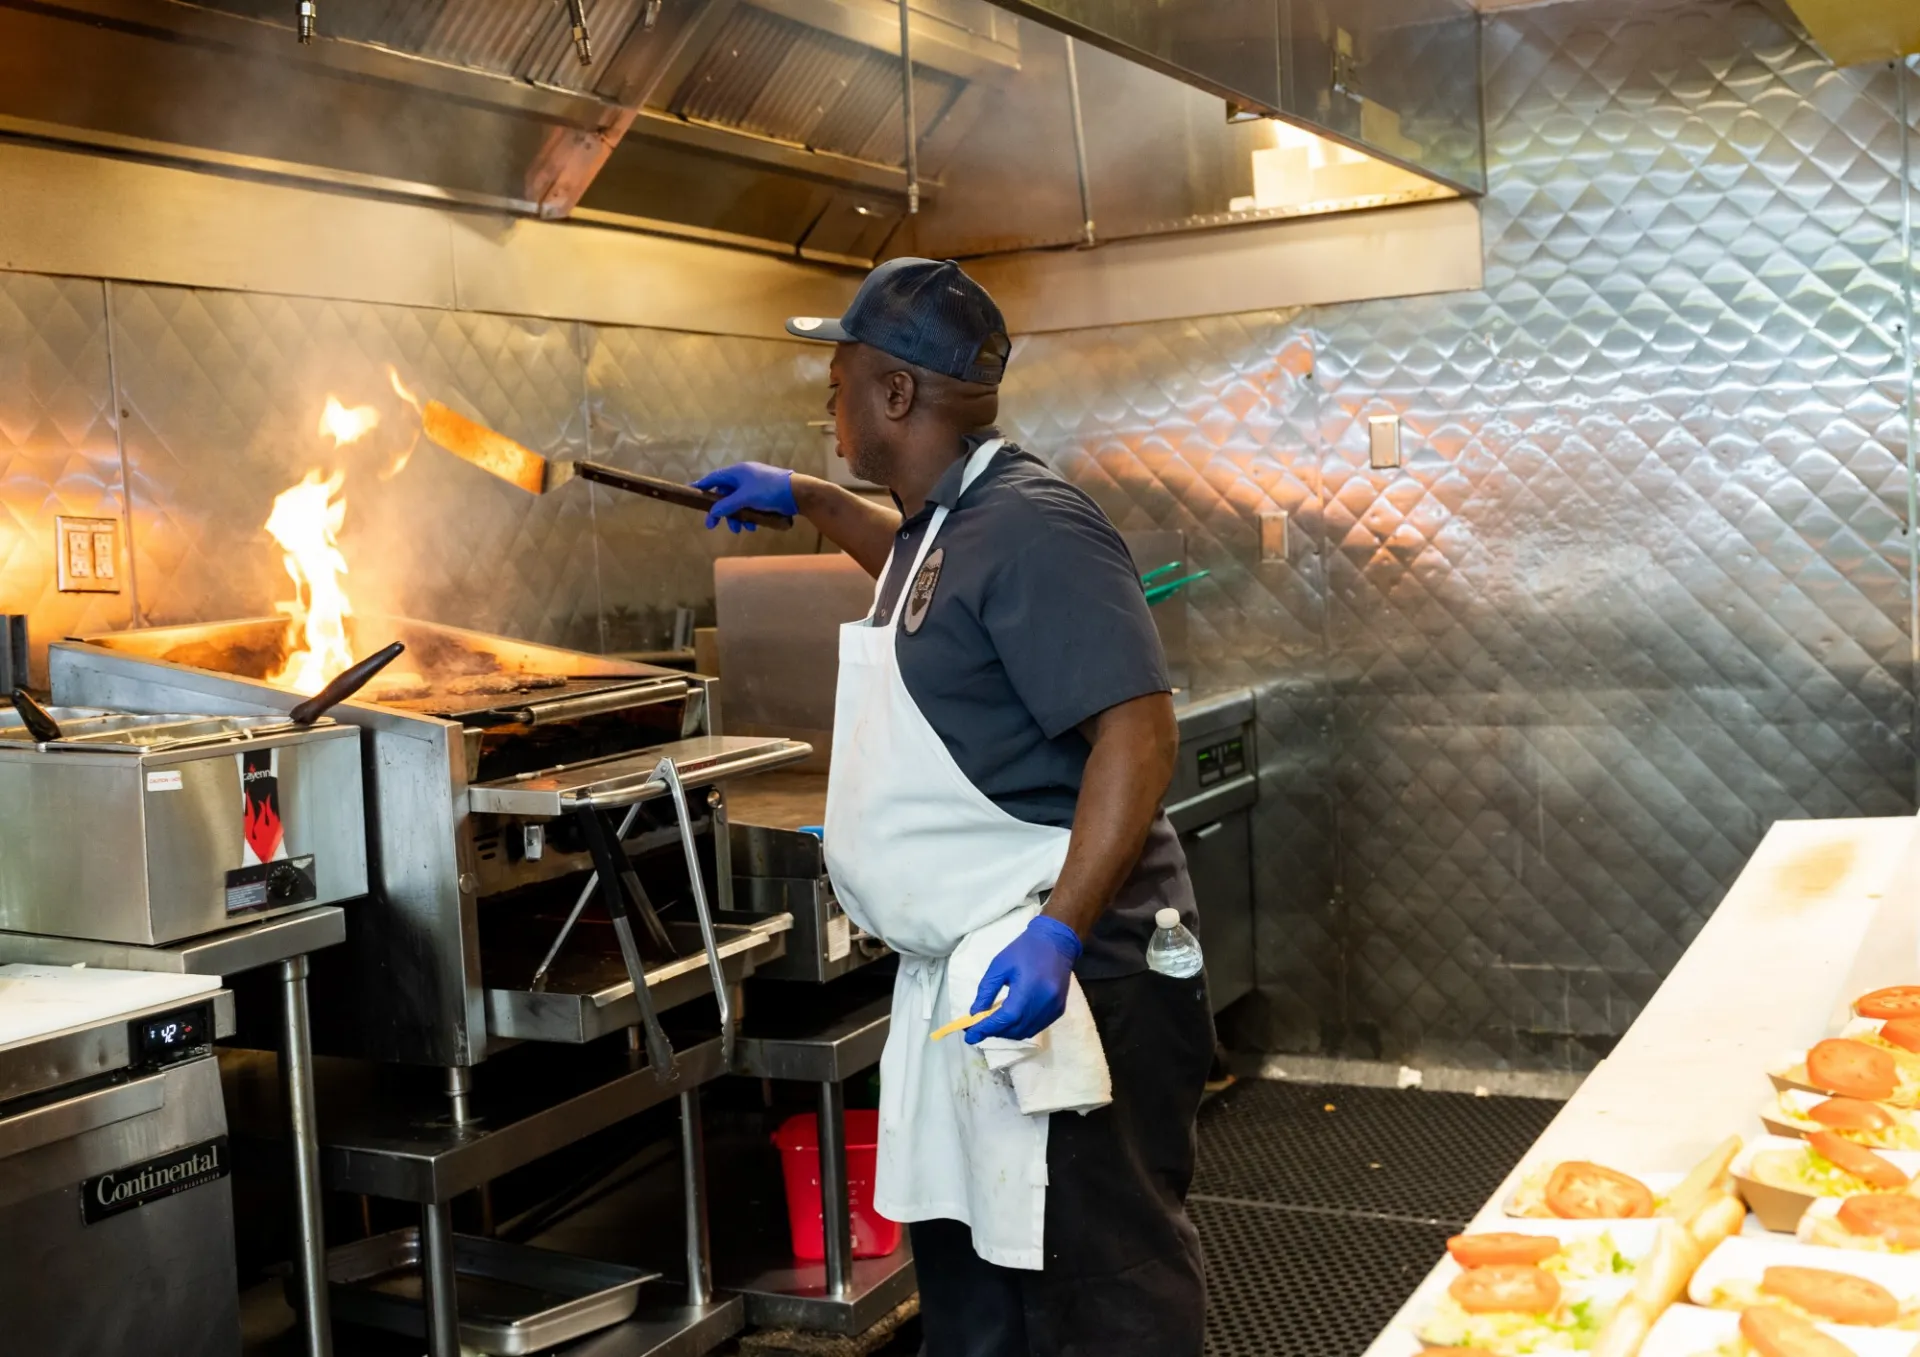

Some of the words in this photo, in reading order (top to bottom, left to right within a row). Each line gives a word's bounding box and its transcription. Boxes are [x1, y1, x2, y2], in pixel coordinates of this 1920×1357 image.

[243, 769, 271, 782] cayenn
[160, 1023, 177, 1044] 42
[97, 1145, 219, 1206] Continental
